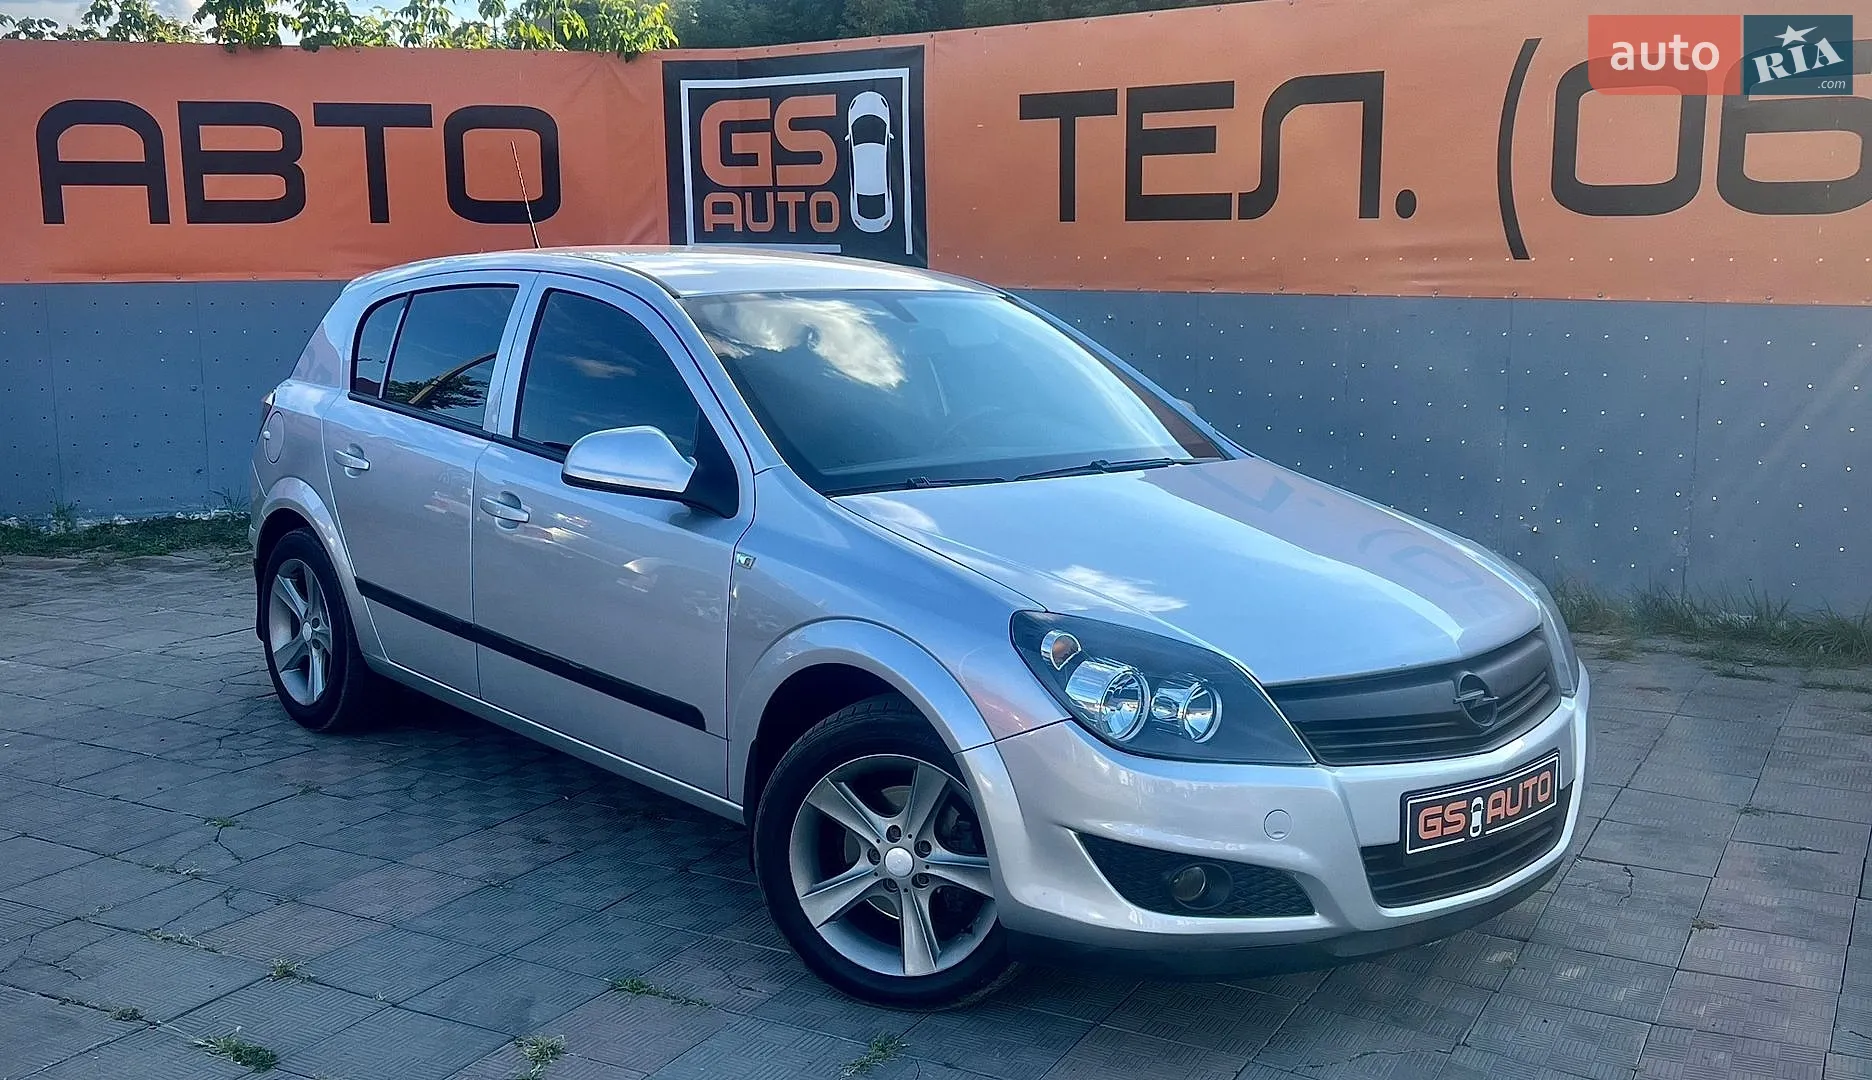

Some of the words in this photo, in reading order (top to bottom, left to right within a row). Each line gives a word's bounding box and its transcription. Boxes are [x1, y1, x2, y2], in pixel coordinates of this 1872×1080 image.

[36, 99, 562, 224] АВТО
[700, 94, 838, 187] GS
[1019, 71, 1417, 222] ТЕЛ.
[703, 191, 840, 233] AUTO
[1418, 800, 1467, 840] GS
[1486, 770, 1552, 824] AUTO
